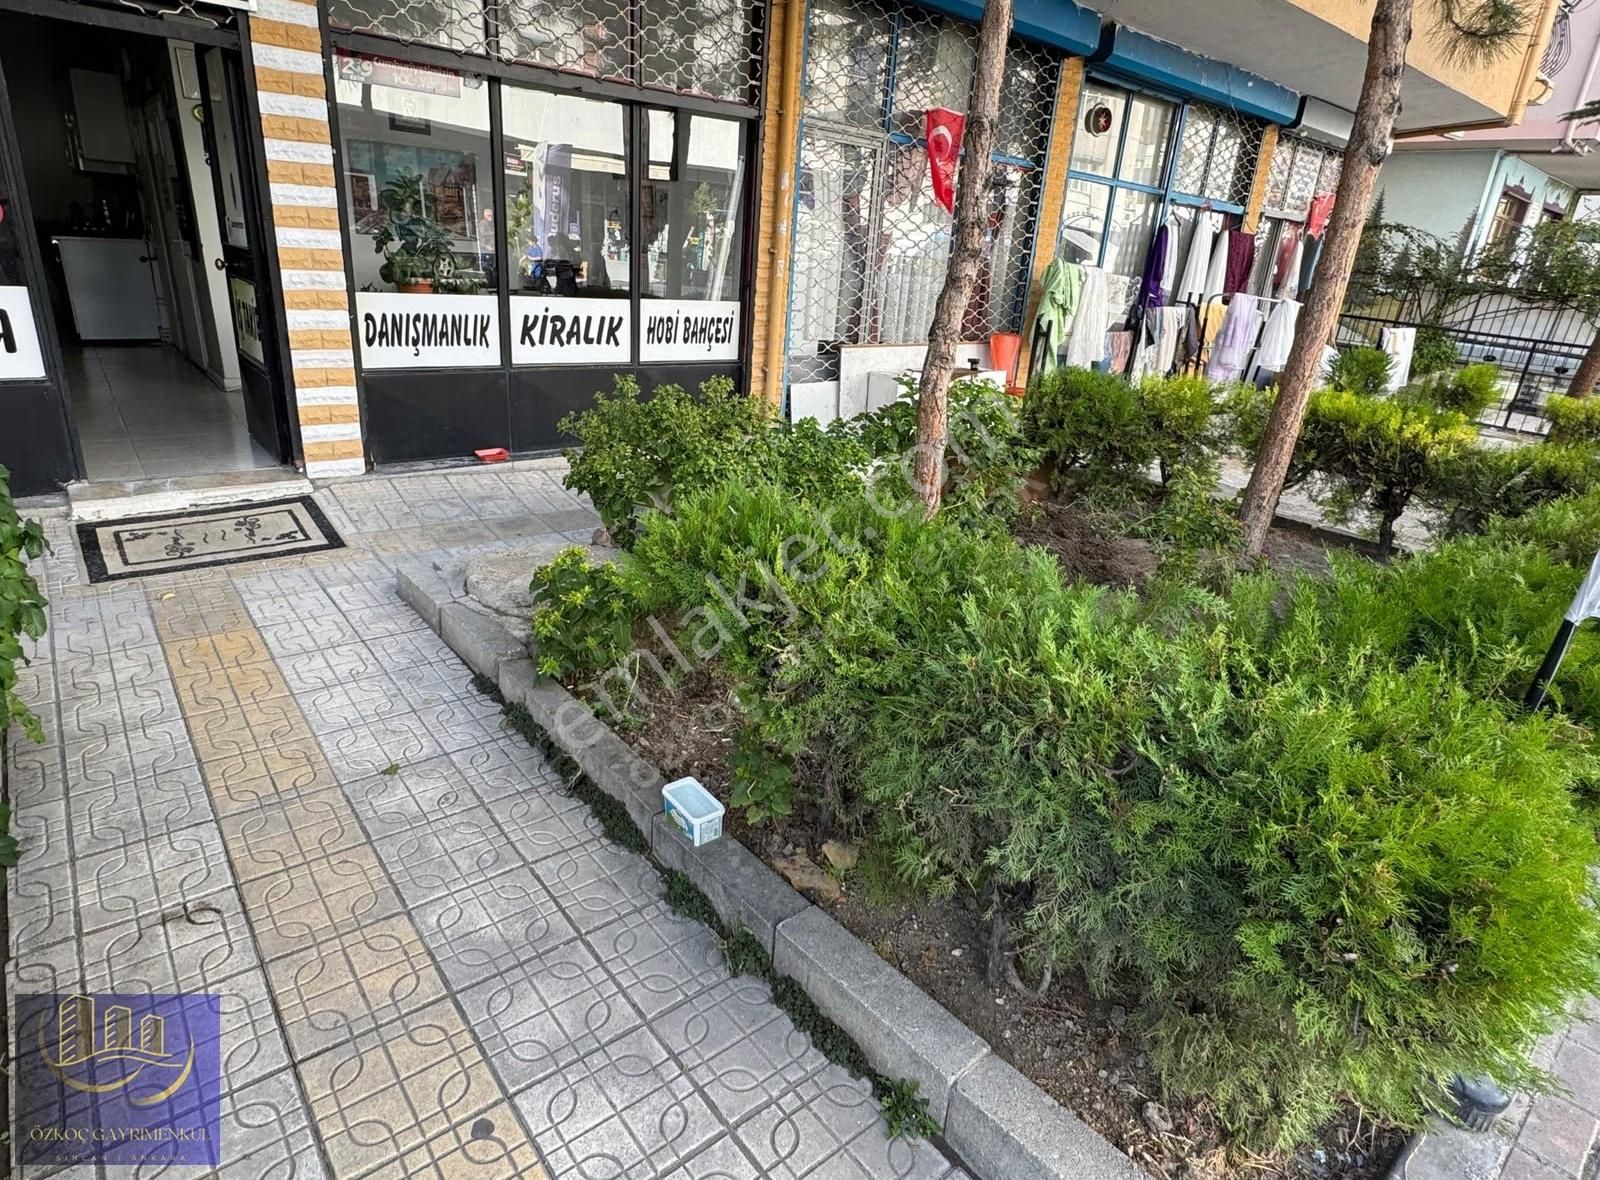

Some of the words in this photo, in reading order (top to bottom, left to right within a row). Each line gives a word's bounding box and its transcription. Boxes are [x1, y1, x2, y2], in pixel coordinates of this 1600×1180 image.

[364, 312, 491, 357] DANIŞMANLIK
[520, 306, 624, 348] KİRALIK
[646, 309, 680, 345] HOBİ
[682, 310, 735, 352] BAHÇESİ
